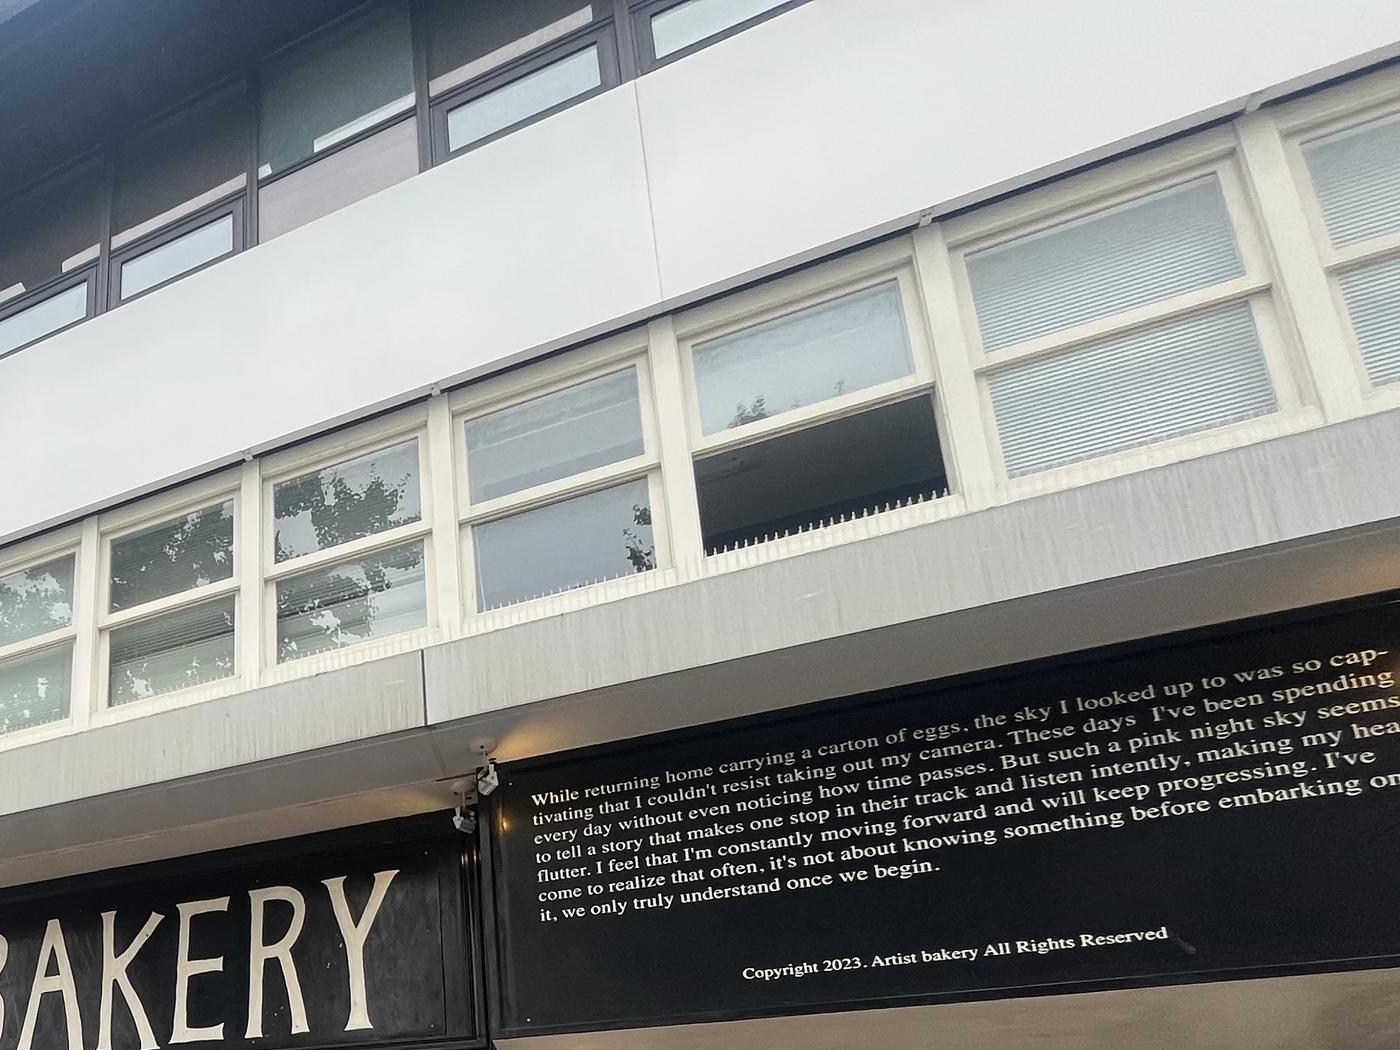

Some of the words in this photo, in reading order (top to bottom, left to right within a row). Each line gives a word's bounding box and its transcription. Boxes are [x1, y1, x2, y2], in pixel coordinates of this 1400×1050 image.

[530, 788, 580, 806] While
[584, 776, 661, 798] returning
[664, 766, 714, 784] home
[718, 751, 796, 774] carrying
[801, 748, 813, 760] a
[817, 737, 880, 756] carton
[885, 727, 908, 745] of
[912, 722, 969, 742] eggs,
[973, 714, 1007, 730] the
[1014, 706, 1052, 722] sky
[1058, 699, 1069, 714] I
[1076, 684, 1156, 712] looked
[1162, 682, 1194, 698] up
[1201, 676, 1226, 690] to
[1232, 665, 1285, 683] was
[1291, 659, 1322, 674] so
[1329, 649, 1390, 667] cap-
[532, 806, 594, 826] tivating
[598, 800, 631, 815] that
[634, 795, 643, 809] I
[647, 783, 718, 806] couldn't
[722, 775, 772, 794] resist
[776, 765, 837, 784] taking
[842, 757, 875, 774] out
[880, 752, 912, 768] my
[918, 738, 1004, 761] camera.
[1006, 725, 1076, 746] These
[1082, 714, 1137, 734] days
[1151, 705, 1196, 722] I've
[1202, 693, 1265, 713] been
[1271, 671, 1396, 705] spending
[533, 828, 578, 845] every
[582, 822, 613, 838] day
[617, 810, 684, 831] without
[688, 804, 731, 820] even
[735, 790, 814, 812] noticing
[817, 782, 861, 799] how
[866, 774, 913, 791] time
[918, 762, 995, 787] passes.
[999, 752, 1042, 770] But
[1047, 741, 1101, 763] such
[1107, 741, 1122, 753] a
[1127, 728, 1183, 754] pink
[1189, 718, 1256, 740] night
[1262, 710, 1308, 728] sky
[1316, 695, 1400, 720] seems
[535, 852, 552, 864] to
[556, 844, 582, 861] tell
[586, 845, 597, 856] a
[601, 838, 644, 854] story
[648, 830, 682, 847] that
[686, 822, 745, 841] makes
[749, 816, 784, 831] one
[789, 809, 830, 825] stop
[835, 803, 856, 818] in
[860, 794, 910, 814] their
[914, 785, 969, 806] track
[974, 776, 1016, 797] and
[1020, 770, 1084, 790] listen
[1090, 753, 1192, 779] intently,
[1196, 738, 1294, 763] making
[1300, 730, 1343, 748] my
[536, 866, 592, 883] flutter.
[596, 860, 604, 875] I
[607, 855, 640, 873] feel
[644, 852, 679, 868] that
[682, 846, 713, 862] I'm
[717, 831, 814, 857] constantly
[820, 820, 898, 842] moving
[902, 804, 988, 830] forward
[993, 796, 1036, 817] and
[1040, 788, 1087, 809] will
[1092, 784, 1151, 803] keep
[1156, 760, 1318, 798] progressing.
[1322, 751, 1377, 769] I've
[538, 887, 583, 902] come
[586, 884, 604, 896] to
[608, 874, 666, 893] realize
[670, 868, 706, 884] that
[709, 862, 765, 879] often,
[769, 854, 798, 871] it's
[802, 850, 836, 866] not
[840, 842, 898, 861] about
[901, 829, 998, 853] knowing
[1002, 811, 1126, 839] something
[1129, 800, 1212, 821] before
[1217, 778, 1364, 809] embarking
[540, 908, 558, 922] it,
[561, 906, 586, 919] we
[590, 898, 628, 916] only
[632, 892, 674, 910] truly
[679, 877, 782, 904] understand
[786, 874, 834, 890] once
[838, 870, 869, 883] we
[873, 858, 941, 880] begin.
[742, 962, 820, 981] Copyright
[822, 956, 868, 972] 2023.
[870, 952, 918, 968] Artist
[920, 948, 979, 963] bakery
[982, 942, 1012, 957] All
[1014, 937, 1076, 955] Rights
[1078, 926, 1169, 948] Reserved
